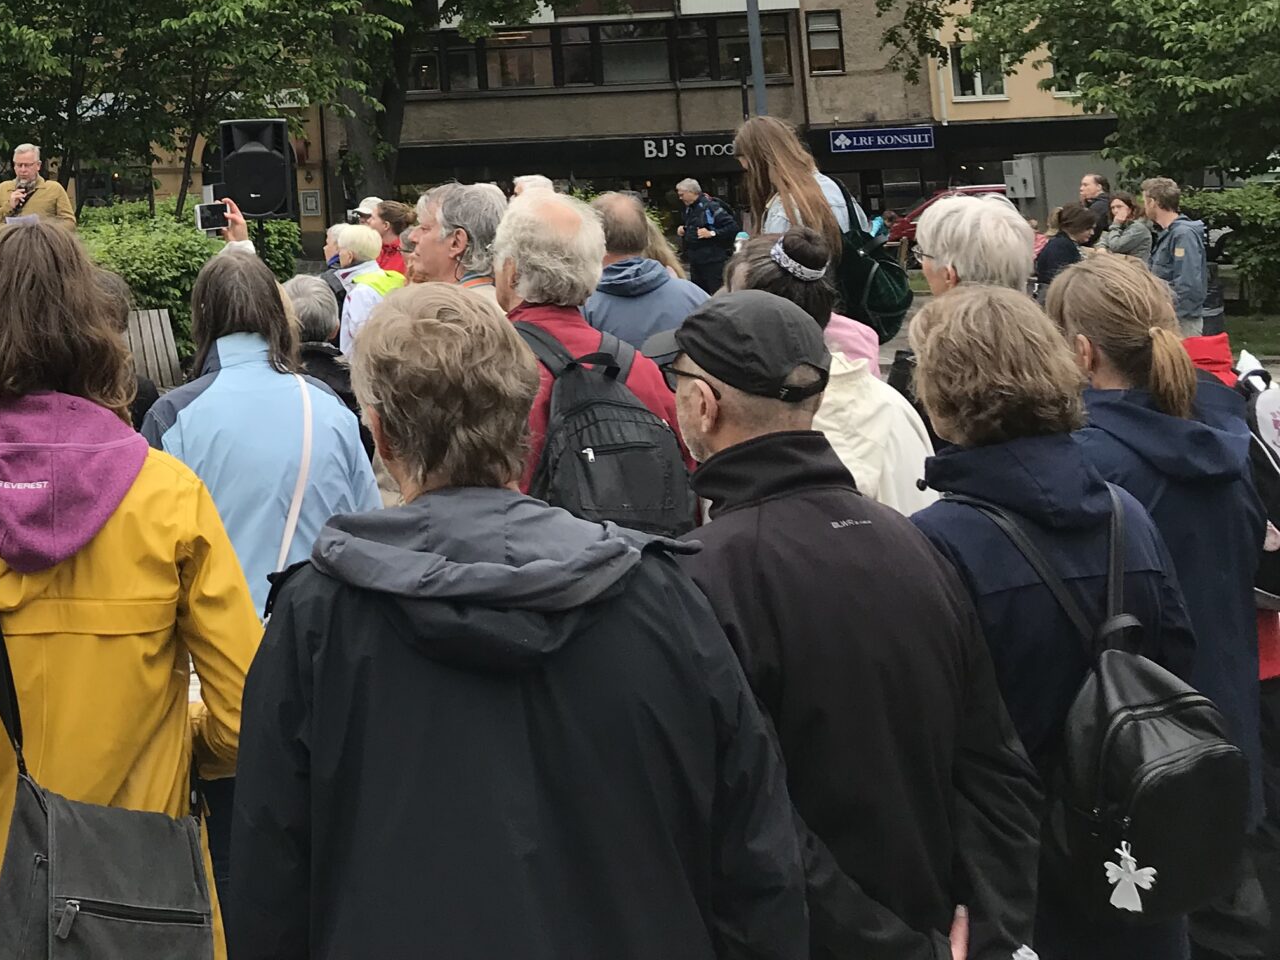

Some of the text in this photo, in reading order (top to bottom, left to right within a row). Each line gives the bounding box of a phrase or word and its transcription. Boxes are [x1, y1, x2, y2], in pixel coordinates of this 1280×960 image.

[852, 134, 931, 146] LRF KONSULT
[643, 139, 687, 158] BJ's
[4, 481, 49, 489] EVEREST
